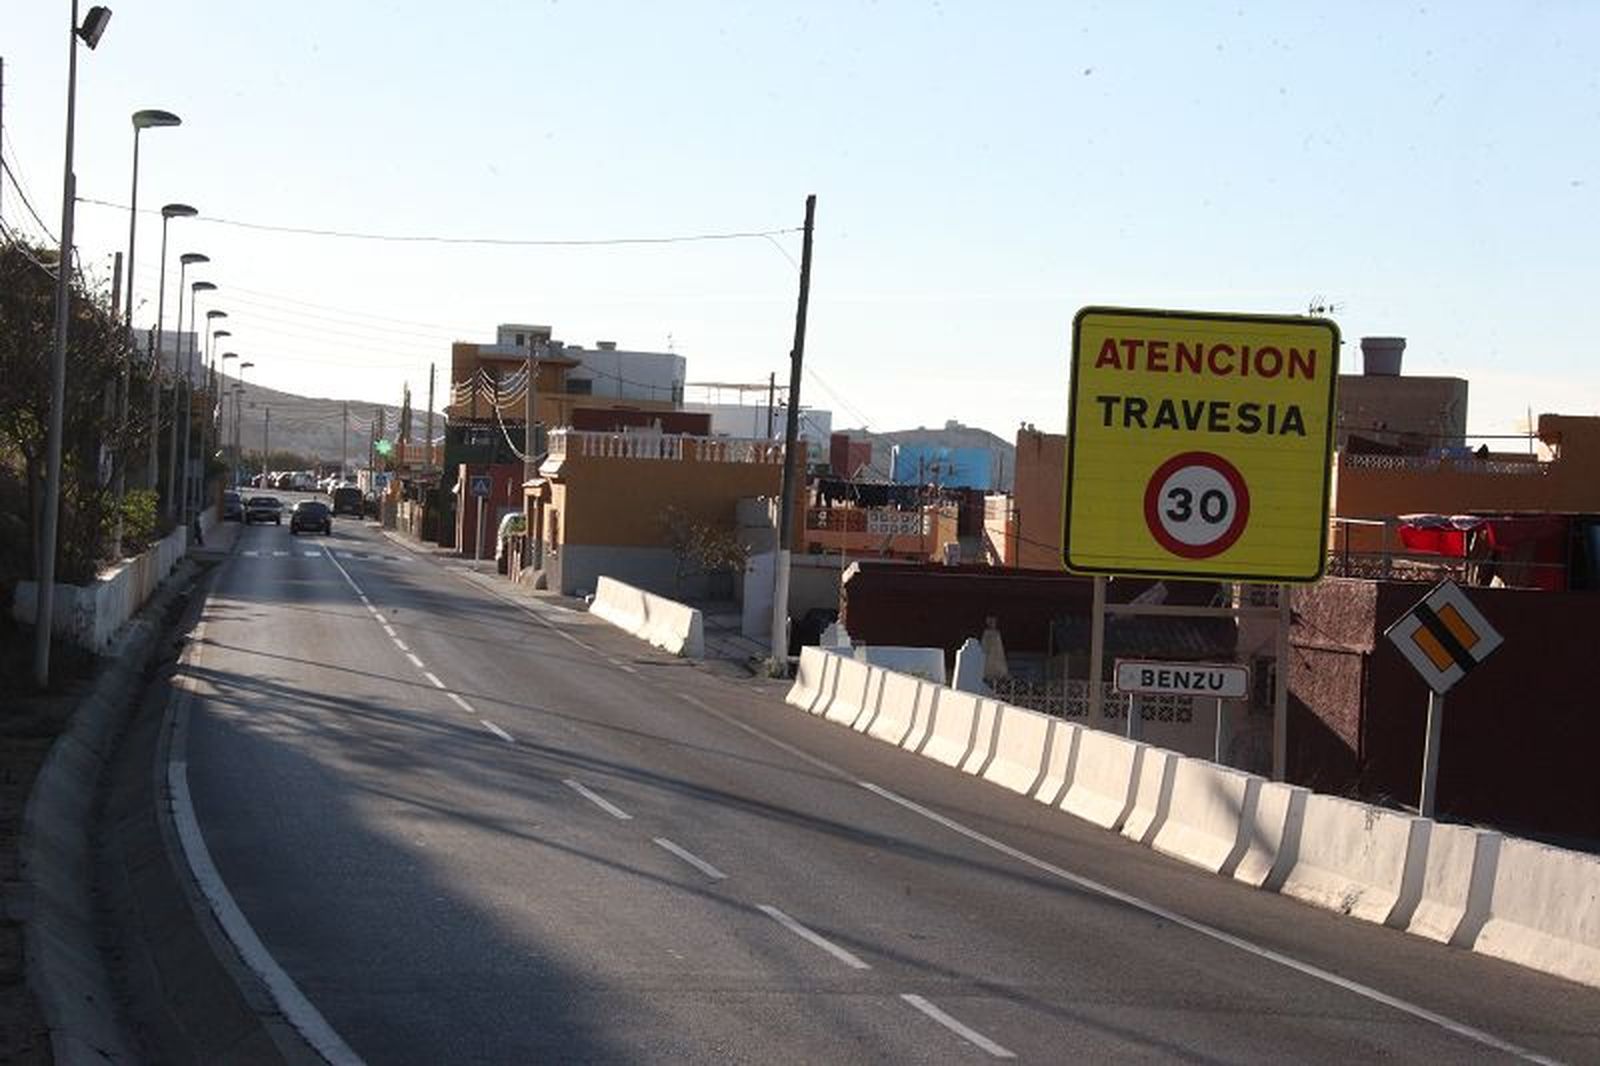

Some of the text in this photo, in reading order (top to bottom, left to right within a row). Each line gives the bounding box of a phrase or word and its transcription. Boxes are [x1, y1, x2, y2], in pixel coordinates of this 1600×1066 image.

[1094, 337, 1317, 381] ATENCION
[1096, 395, 1307, 437] TRAVESIA
[1165, 487, 1229, 525] 30
[1140, 668, 1225, 691] BENZU
